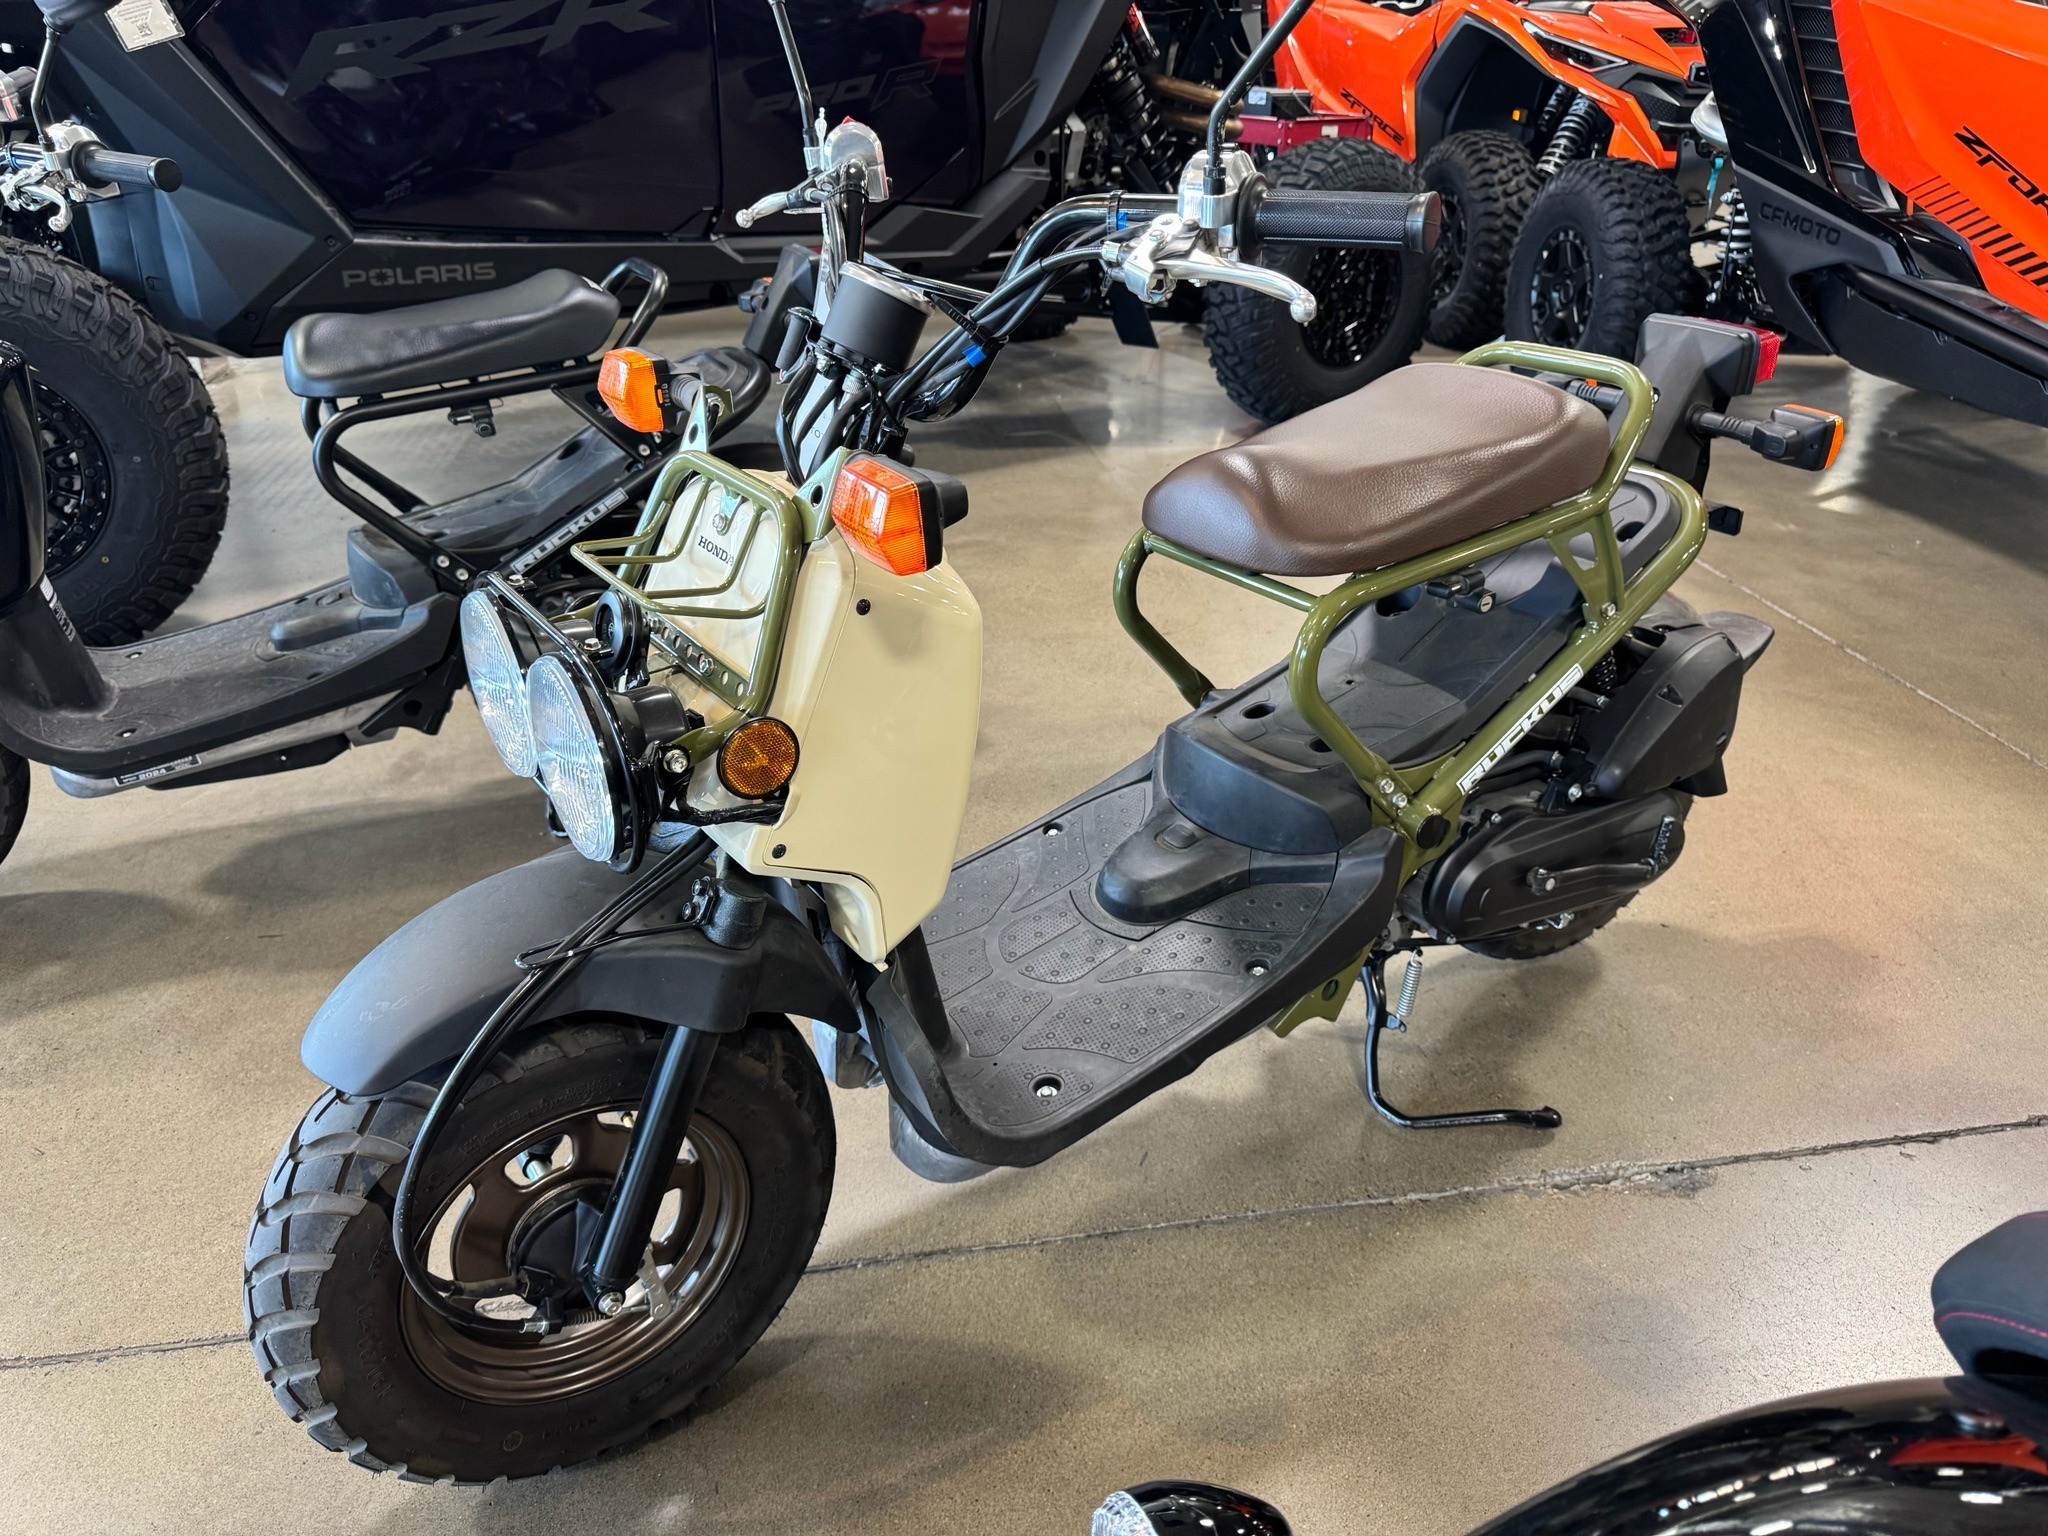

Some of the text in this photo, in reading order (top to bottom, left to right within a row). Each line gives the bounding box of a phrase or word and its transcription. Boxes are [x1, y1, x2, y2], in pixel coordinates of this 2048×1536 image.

[1758, 201, 1842, 246] CFMOTO
[341, 261, 498, 289] POLARIS
[511, 487, 629, 575] RUCKUS
[698, 535, 735, 567] HONDA
[1456, 663, 1584, 796] RUCKUS
